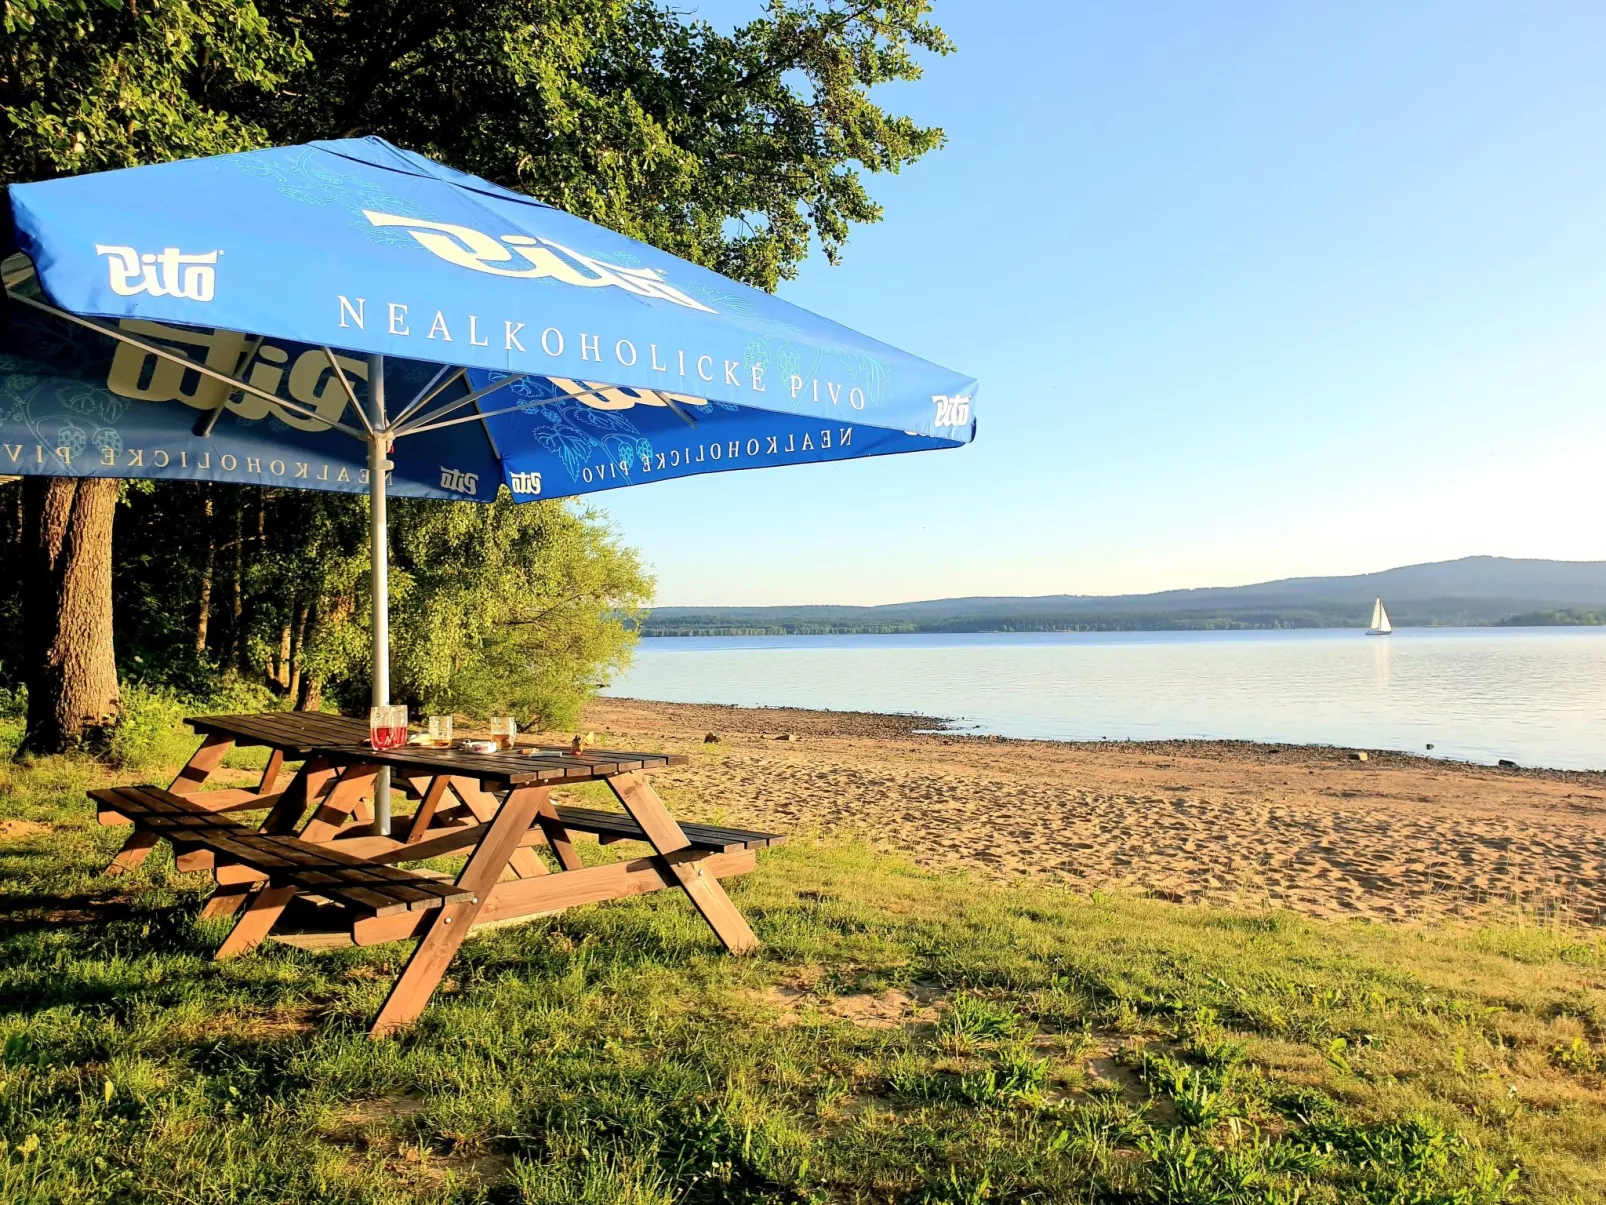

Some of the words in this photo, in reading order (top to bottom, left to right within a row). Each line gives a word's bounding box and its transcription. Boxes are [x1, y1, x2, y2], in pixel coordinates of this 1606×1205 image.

[95, 244, 217, 302] Pito
[337, 295, 765, 392] NEALKOHOLICKÉ
[791, 374, 865, 410] PIVO
[931, 394, 970, 428] Pito
